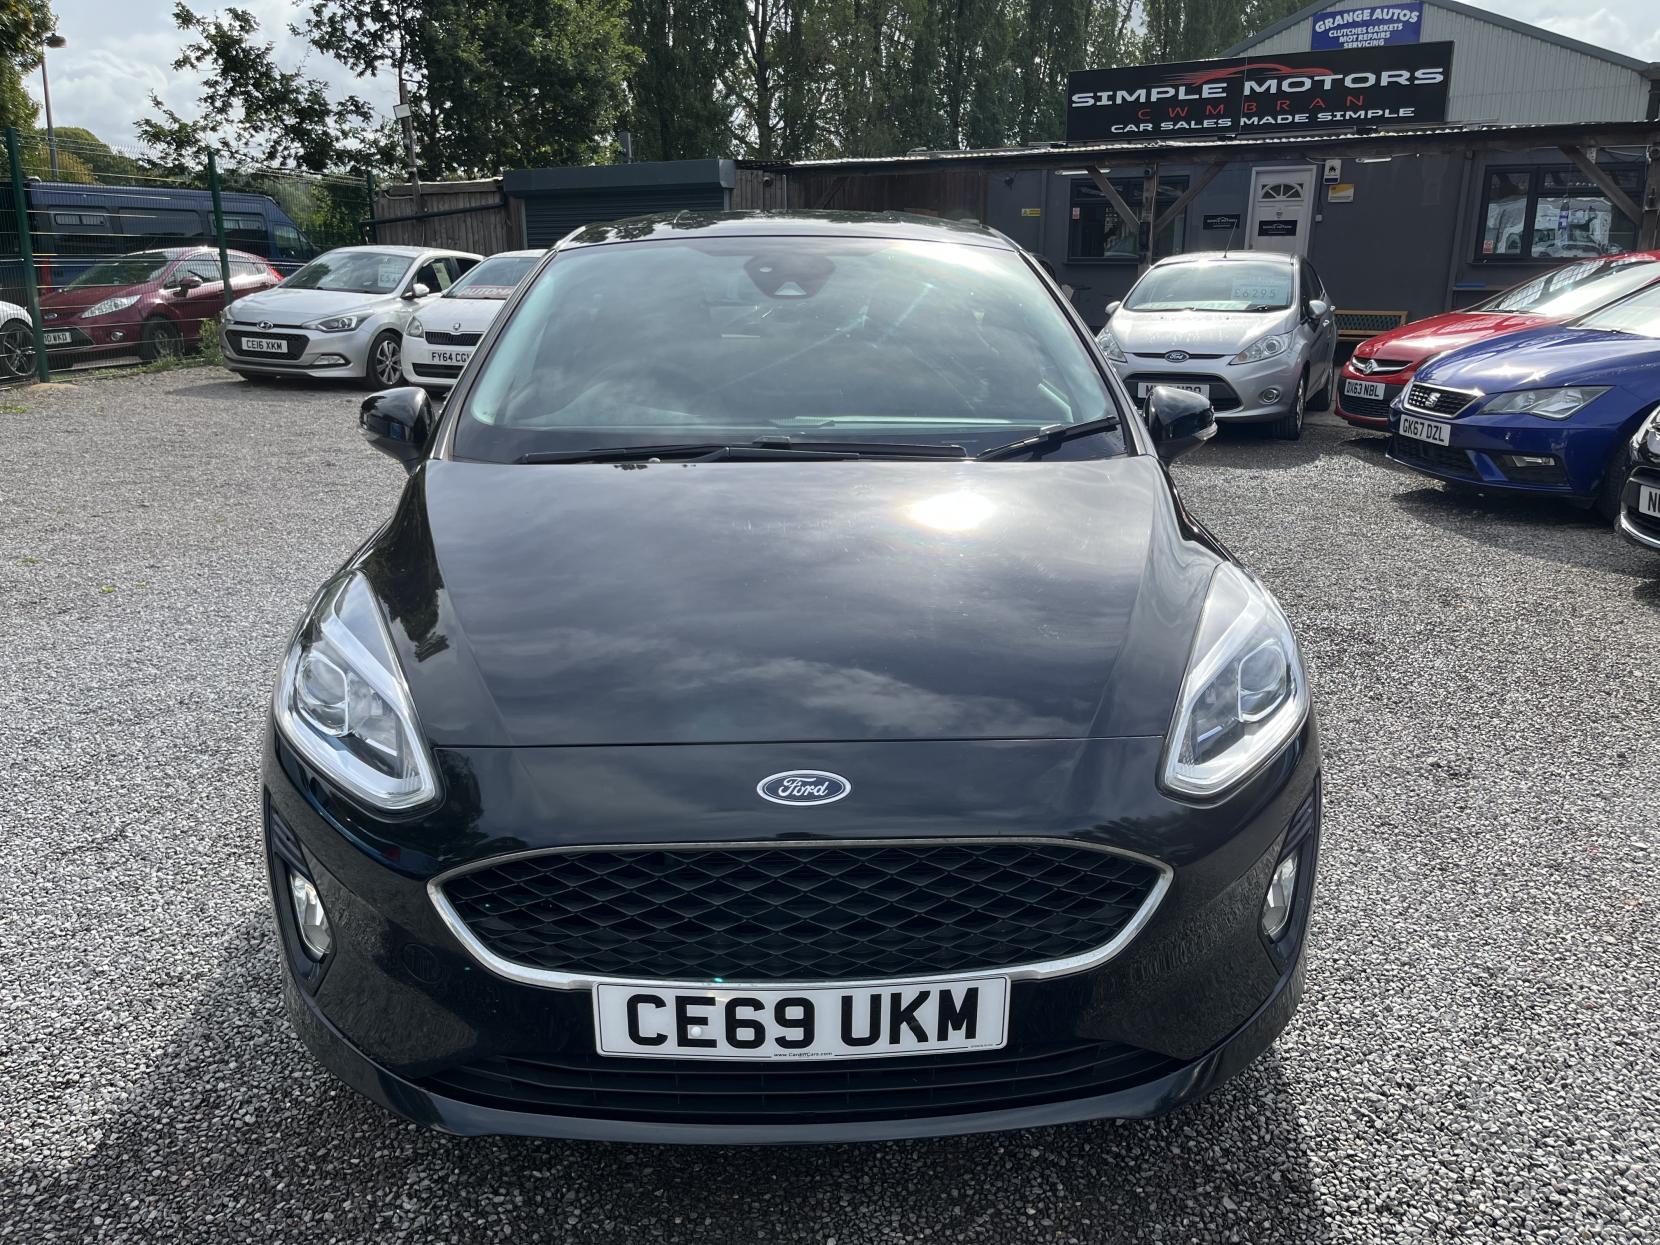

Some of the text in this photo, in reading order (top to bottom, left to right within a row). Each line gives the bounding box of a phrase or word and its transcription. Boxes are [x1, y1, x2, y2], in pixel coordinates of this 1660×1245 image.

[1315, 8, 1420, 32] GRANGE AUTOS
[1328, 23, 1403, 37] CLUTCHES GASKETS
[1339, 31, 1391, 43] MOT REPAIRS
[1343, 39, 1385, 49] SERVICING
[1071, 67, 1444, 108] SIMPLE MOTORS
[1137, 95, 1364, 120] CWMBRAN
[1111, 108, 1415, 133] CAR SALES MADE SIMPLE
[246, 339, 283, 351] CE16 XKM
[431, 351, 453, 363] FY64
[1364, 383, 1380, 398] NBL
[1402, 418, 1445, 442] GK67 DZL
[1647, 490, 1660, 513] N
[778, 777, 829, 797] Ford
[627, 987, 979, 1049] CE69 UKM
